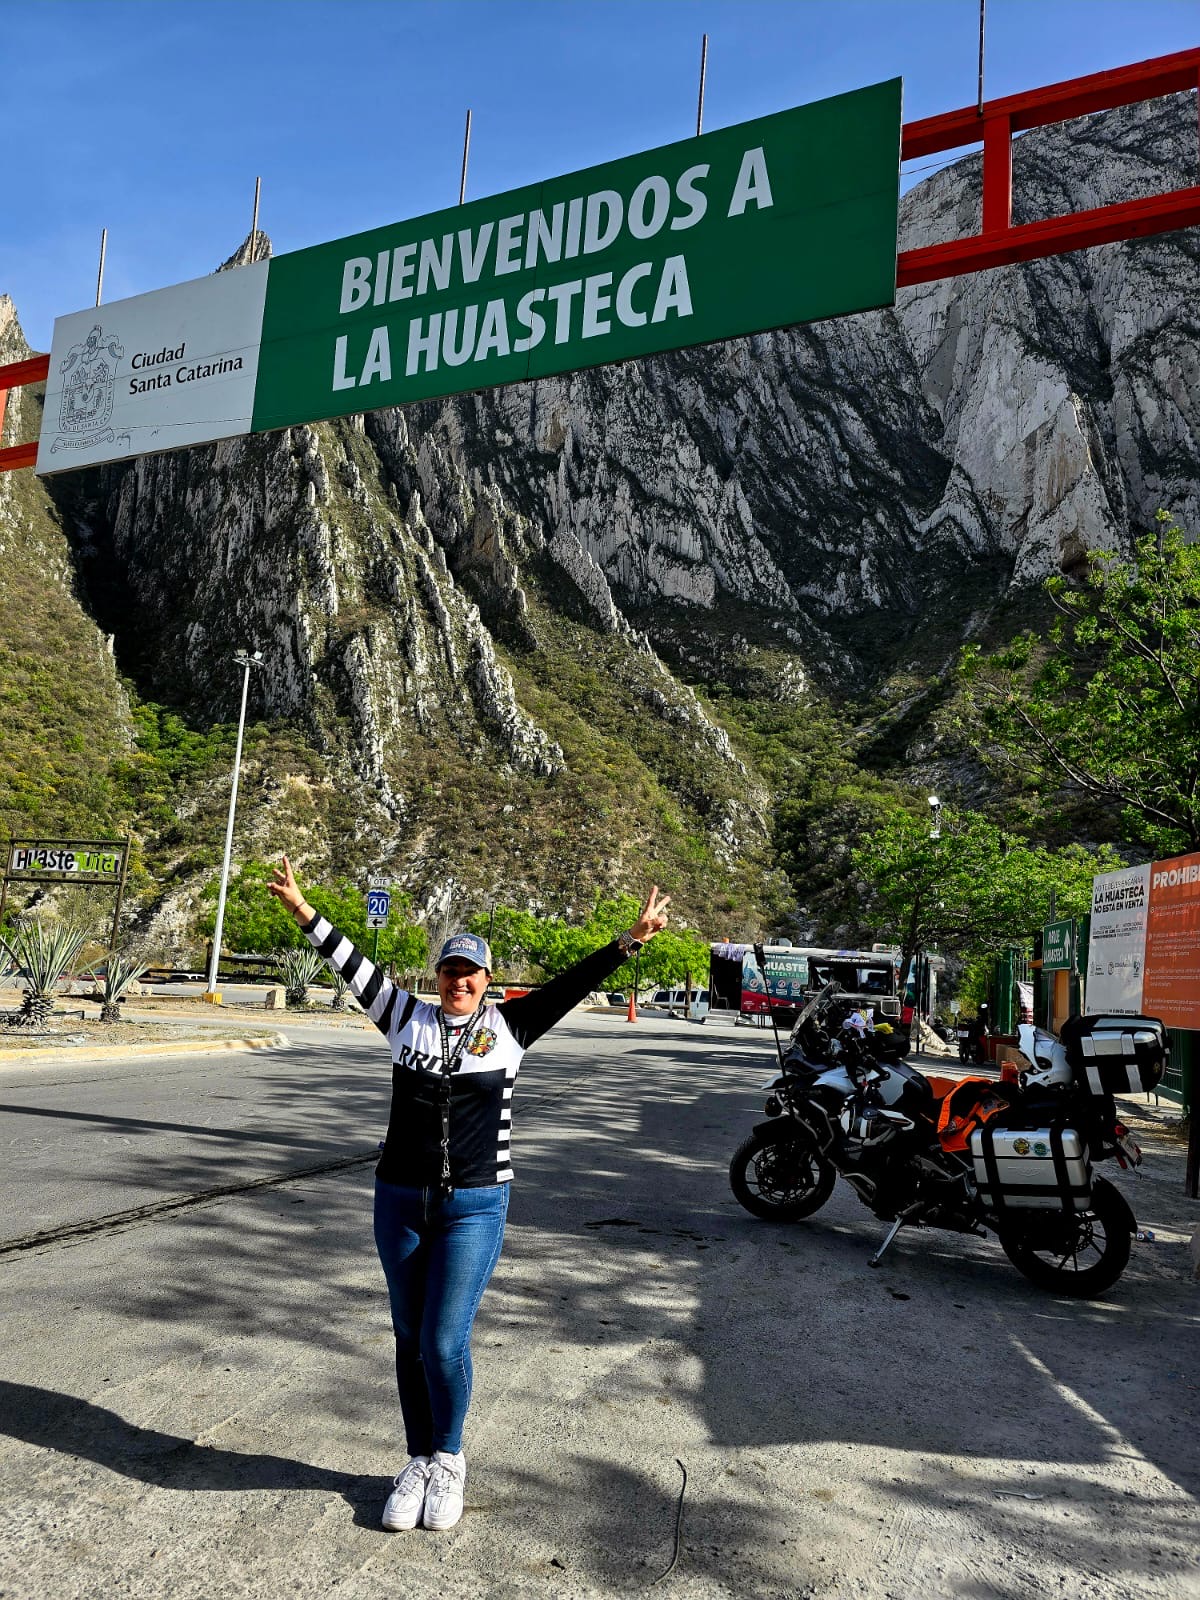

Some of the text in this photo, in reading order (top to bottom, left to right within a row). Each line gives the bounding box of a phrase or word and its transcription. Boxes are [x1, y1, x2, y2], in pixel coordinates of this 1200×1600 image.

[340, 147, 774, 314] BIENVENIDOS A
[332, 255, 694, 392] LA HUASTECA
[131, 343, 186, 370] Ciudad
[129, 374, 171, 395] Santa
[176, 356, 243, 384] Catarina
[370, 898, 386, 914] 20
[1094, 886, 1144, 904] LA HUASTECA
[1094, 905, 1102, 914] NO
[1116, 902, 1124, 910] EN
[1124, 898, 1144, 910] VENTA
[764, 961, 808, 973] HUASTE
